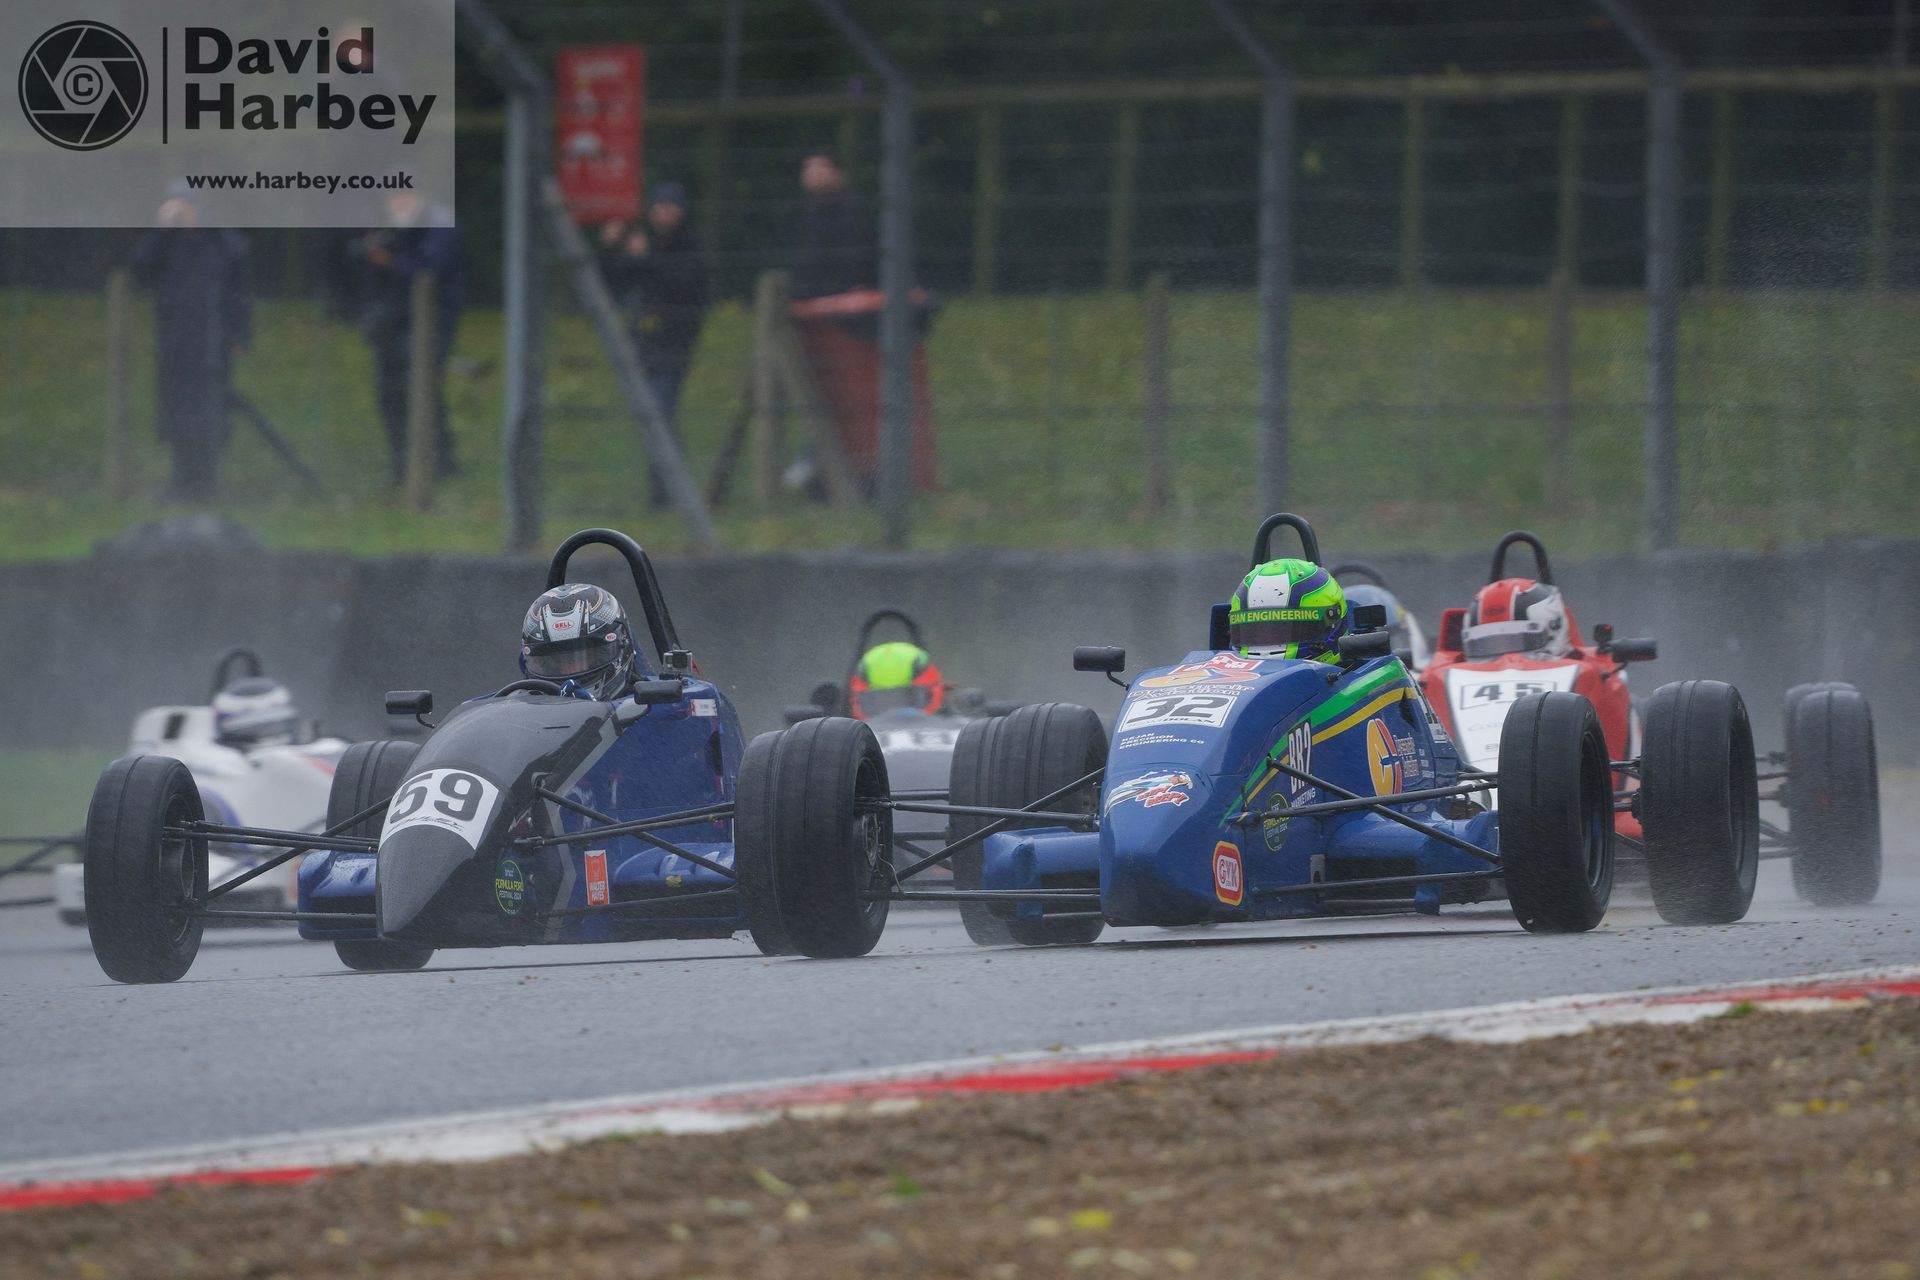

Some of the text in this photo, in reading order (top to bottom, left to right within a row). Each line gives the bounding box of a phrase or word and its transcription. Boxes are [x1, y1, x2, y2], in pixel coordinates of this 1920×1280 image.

[1247, 609, 1320, 622] ENGINEERING
[554, 621, 572, 630] BELL
[1126, 696, 1230, 724] 32
[1119, 738, 1188, 750] ENGINEERING
[389, 772, 484, 824] 59
